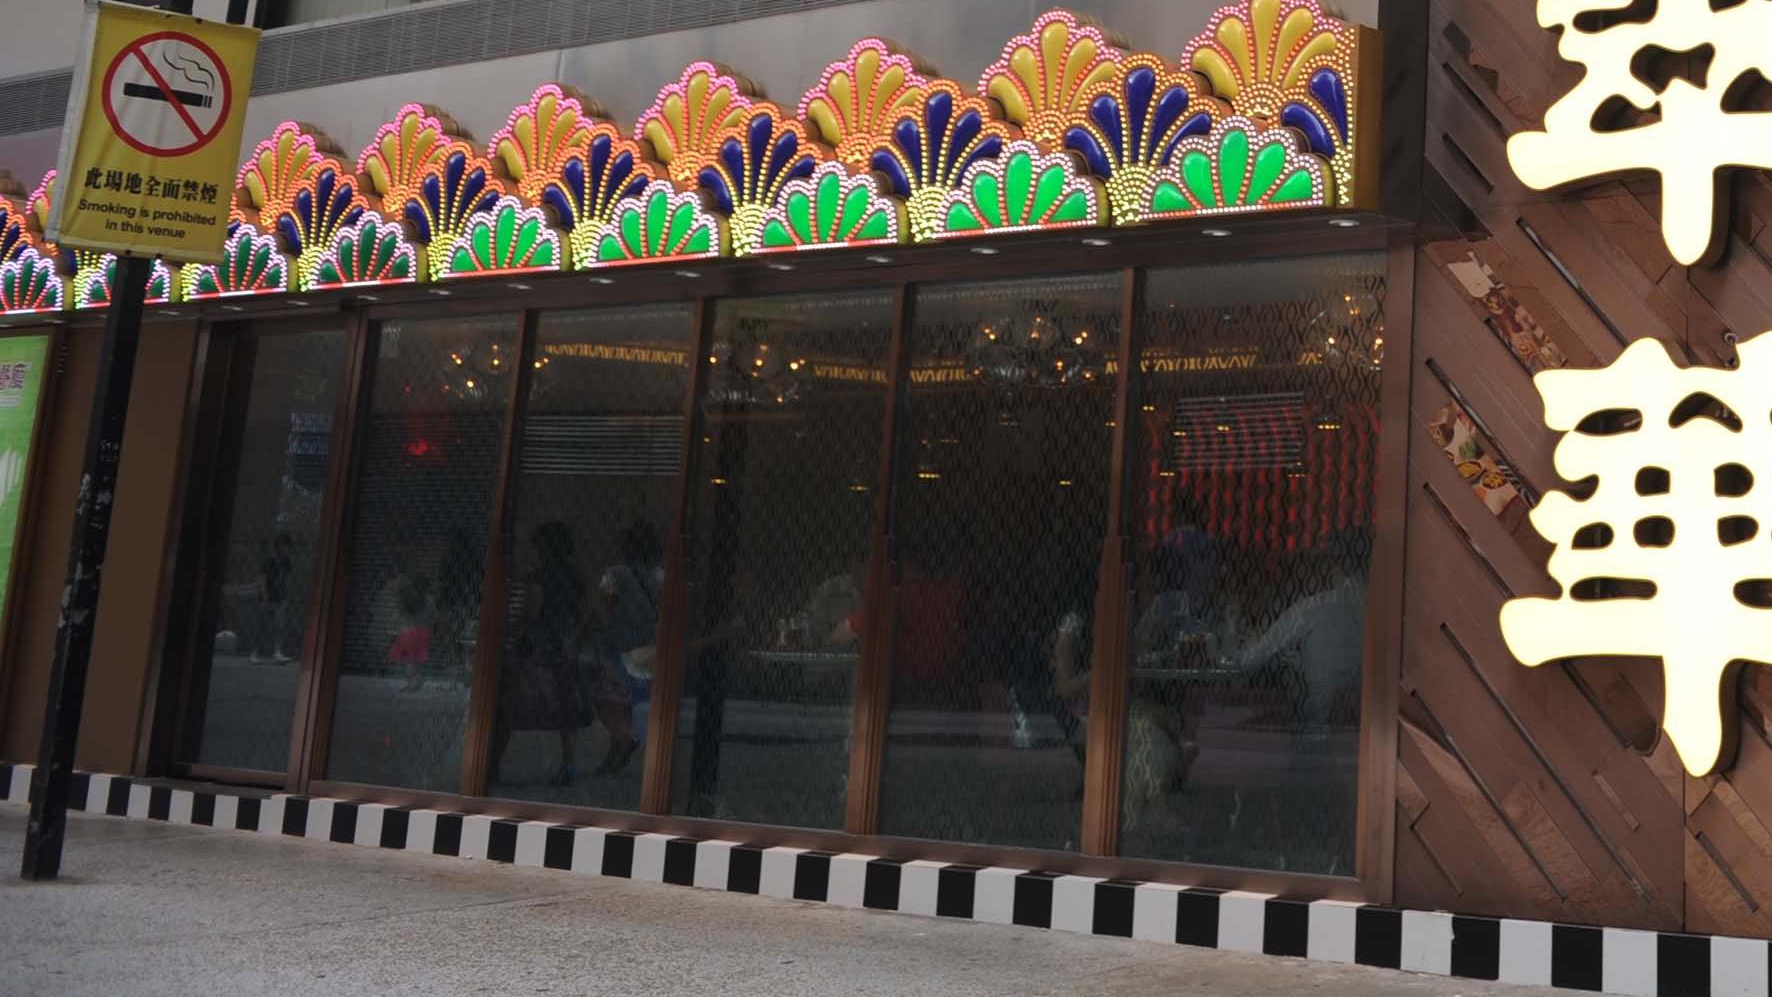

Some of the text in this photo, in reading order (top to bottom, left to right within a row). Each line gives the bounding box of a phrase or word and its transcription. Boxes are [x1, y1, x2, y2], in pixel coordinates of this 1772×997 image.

[85, 167, 219, 205] 此場地全面禁煙
[79, 199, 216, 226] Smoking is prohibited
[105, 219, 186, 238] in this venue
